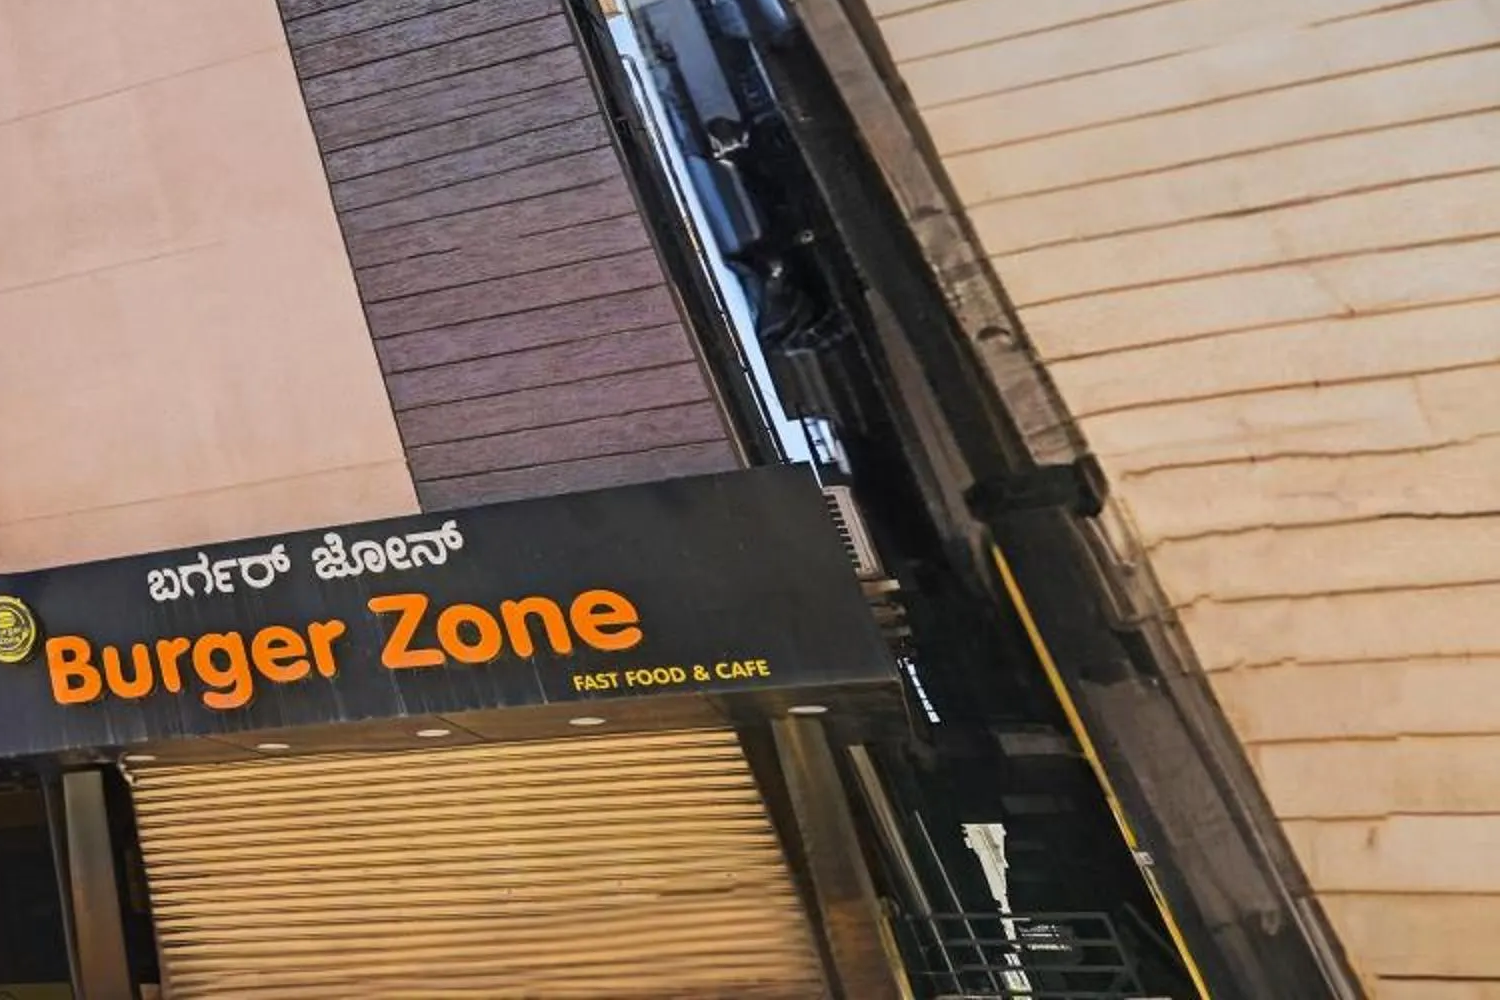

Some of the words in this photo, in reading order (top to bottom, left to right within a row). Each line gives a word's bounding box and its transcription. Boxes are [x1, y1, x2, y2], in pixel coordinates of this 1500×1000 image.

[146, 543, 292, 602] ಬರ್ಗರ್
[311, 519, 464, 581] ಜೋನ್
[44, 618, 346, 707] Burger
[367, 589, 644, 669] Zone
[572, 672, 620, 691] FAST
[625, 666, 687, 687] FOOD
[692, 664, 711, 682] &
[714, 659, 771, 680] CAFE
